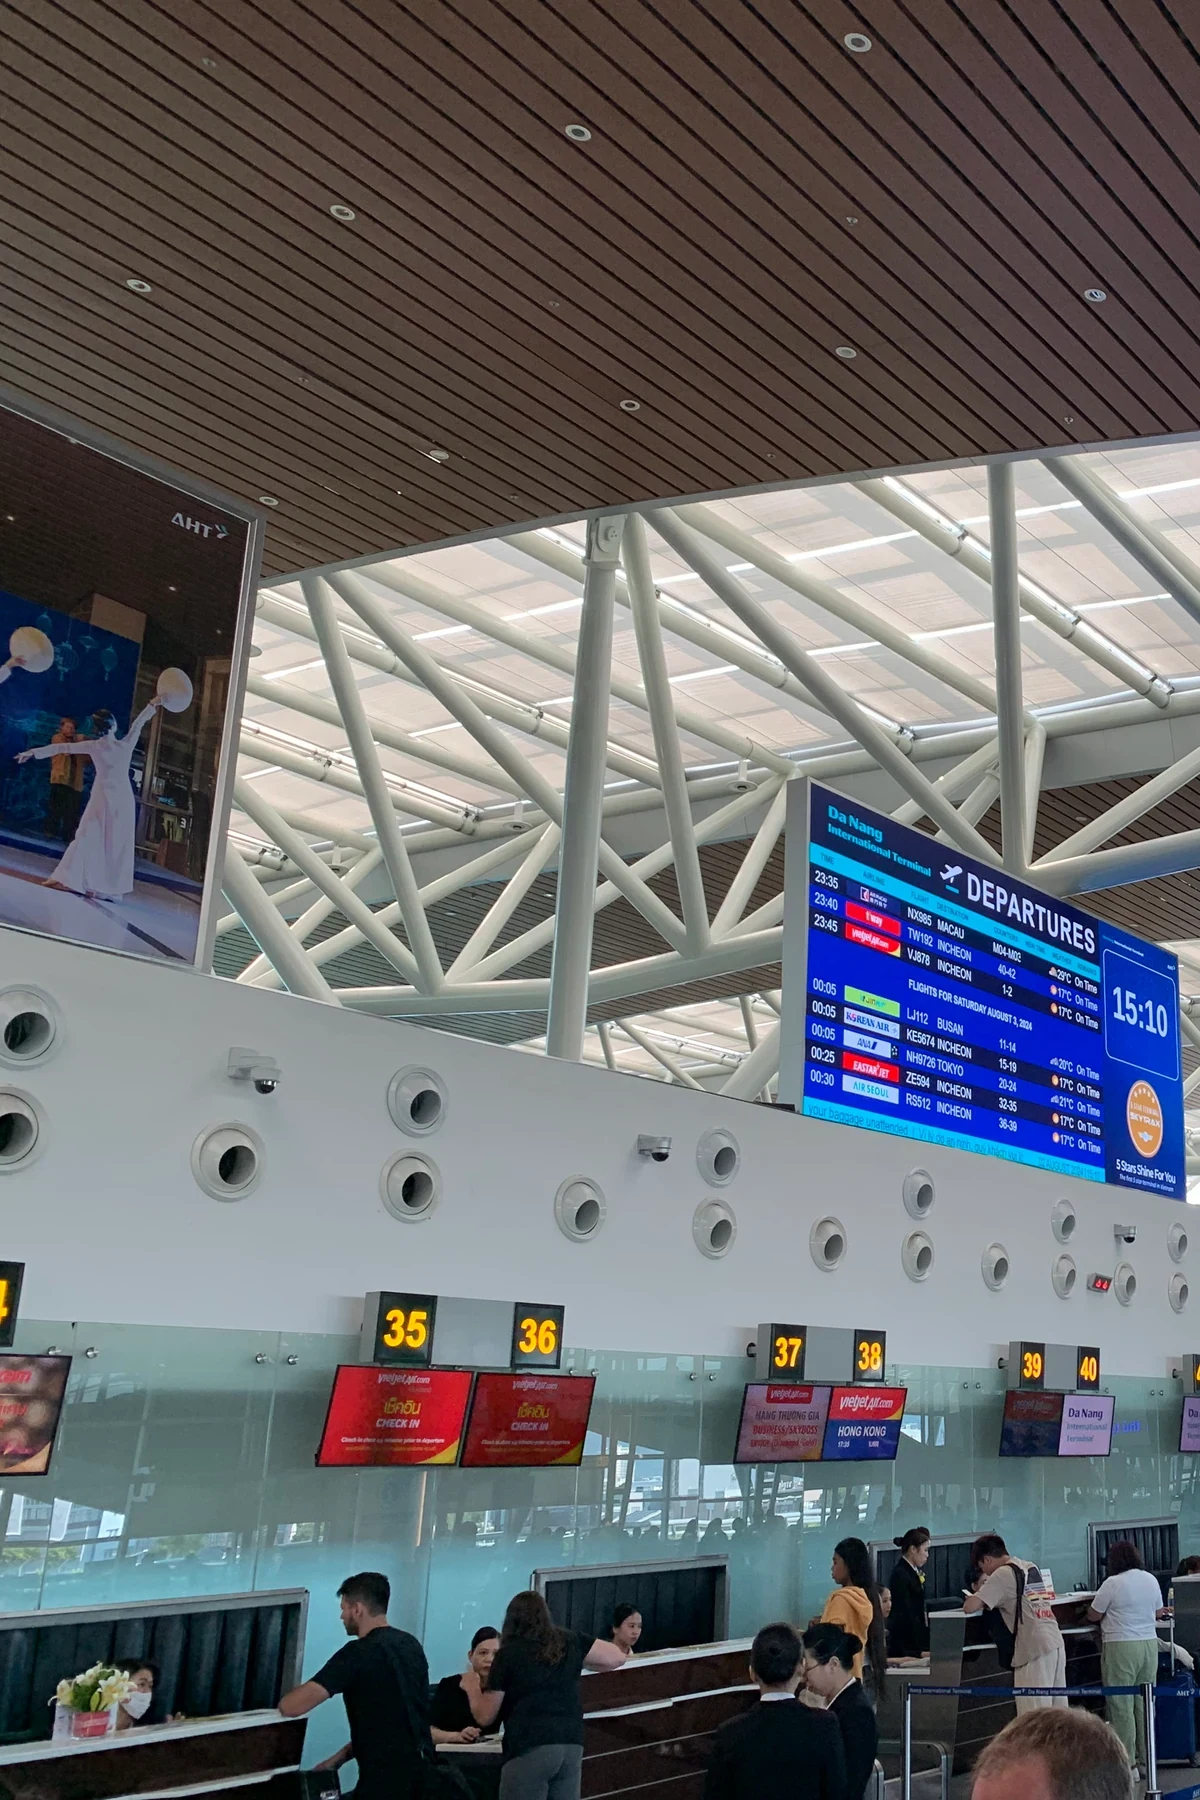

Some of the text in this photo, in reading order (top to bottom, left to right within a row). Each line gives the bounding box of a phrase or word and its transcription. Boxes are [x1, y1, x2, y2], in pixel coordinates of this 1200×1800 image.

[171, 512, 212, 538] AHT
[828, 805, 883, 842] Da Nang
[828, 823, 931, 877] International Terminal
[967, 872, 1095, 954] DEPARTURES
[815, 870, 838, 889] 23:35
[907, 907, 932, 926] NX985
[937, 919, 965, 939] MACAU
[1075, 976, 1084, 988] On
[1084, 980, 1098, 994] Time
[815, 892, 838, 910] 23:40
[908, 927, 933, 947] TW192
[938, 939, 972, 962] INCHEON
[998, 964, 1017, 979] 40-42
[1075, 994, 1084, 1006] On
[1084, 997, 1098, 1012] Time
[814, 914, 838, 932] 23:45
[907, 948, 930, 966] VJ878
[938, 959, 972, 982] INCHEON
[1002, 984, 1013, 997] 1-2
[1075, 1012, 1084, 1024] On
[1085, 1015, 1099, 1029] Time
[909, 979, 1033, 1031] FLIGHTS FOR SATURDAY AUGUST 3, 2024
[1113, 986, 1168, 1037] 15:10
[813, 977, 837, 996] 00:05
[907, 1008, 929, 1025] LJ112
[937, 1017, 964, 1036] BUSAN
[999, 1038, 1017, 1053] 11-14
[1076, 1064, 1085, 1076] On
[1086, 1067, 1100, 1081] Time
[812, 1000, 836, 1018] 00:05
[846, 1011, 875, 1028] KOREAN
[876, 1021, 890, 1033] AIR
[907, 1028, 935, 1048] KE5674
[938, 1037, 972, 1059] INCHEON
[999, 1058, 1017, 1073] 15-19
[1077, 1083, 1086, 1094] On
[1086, 1085, 1100, 1099] Time
[812, 1023, 836, 1041] 00:05
[857, 1037, 871, 1049] ANA
[907, 1050, 936, 1069] NH9726
[937, 1058, 964, 1077] TOKYO
[999, 1077, 1017, 1092] 20-24
[1077, 1102, 1086, 1113] On
[1087, 1104, 1100, 1117] Time
[811, 1046, 835, 1064] 00:25
[853, 1060, 878, 1076] EASTAR
[878, 1068, 890, 1079] JET
[906, 1071, 930, 1088] ZE594
[937, 1080, 972, 1100] INCHEON
[999, 1097, 1017, 1113] 32-35
[1077, 1120, 1087, 1132] On
[1087, 1122, 1101, 1136] Time
[808, 1104, 908, 1136] your baggage unattended
[811, 1069, 835, 1086] 00:30
[853, 1081, 865, 1092] AIR
[867, 1085, 889, 1098] SEOUL
[906, 1093, 931, 1110] RS512
[937, 1101, 972, 1121] INCHEON
[999, 1117, 1018, 1132] 36-39
[1078, 1139, 1087, 1150] On
[1088, 1141, 1101, 1155] Time
[1130, 1112, 1161, 1128] SKYTRAX
[1116, 1159, 1121, 1170] 5
[1121, 1160, 1137, 1174] Stars
[1137, 1164, 1154, 1179] Shine
[1154, 1169, 1164, 1181] For
[1164, 1171, 1176, 1184] You
[383, 1309, 427, 1348] 35
[518, 1318, 557, 1355] 36
[775, 1337, 802, 1367] 37
[858, 1342, 881, 1371] 38
[1023, 1352, 1042, 1378] 39
[1080, 1356, 1097, 1381] 40
[376, 1418, 420, 1429] CHECK IN
[511, 1422, 548, 1431] CHECK IN
[808, 1411, 820, 1421] GIA
[1067, 1423, 1108, 1431] International
[1068, 1408, 1103, 1421] Da Nang
[1188, 1409, 1199, 1418] Da
[838, 1426, 887, 1437] HONG KONG
